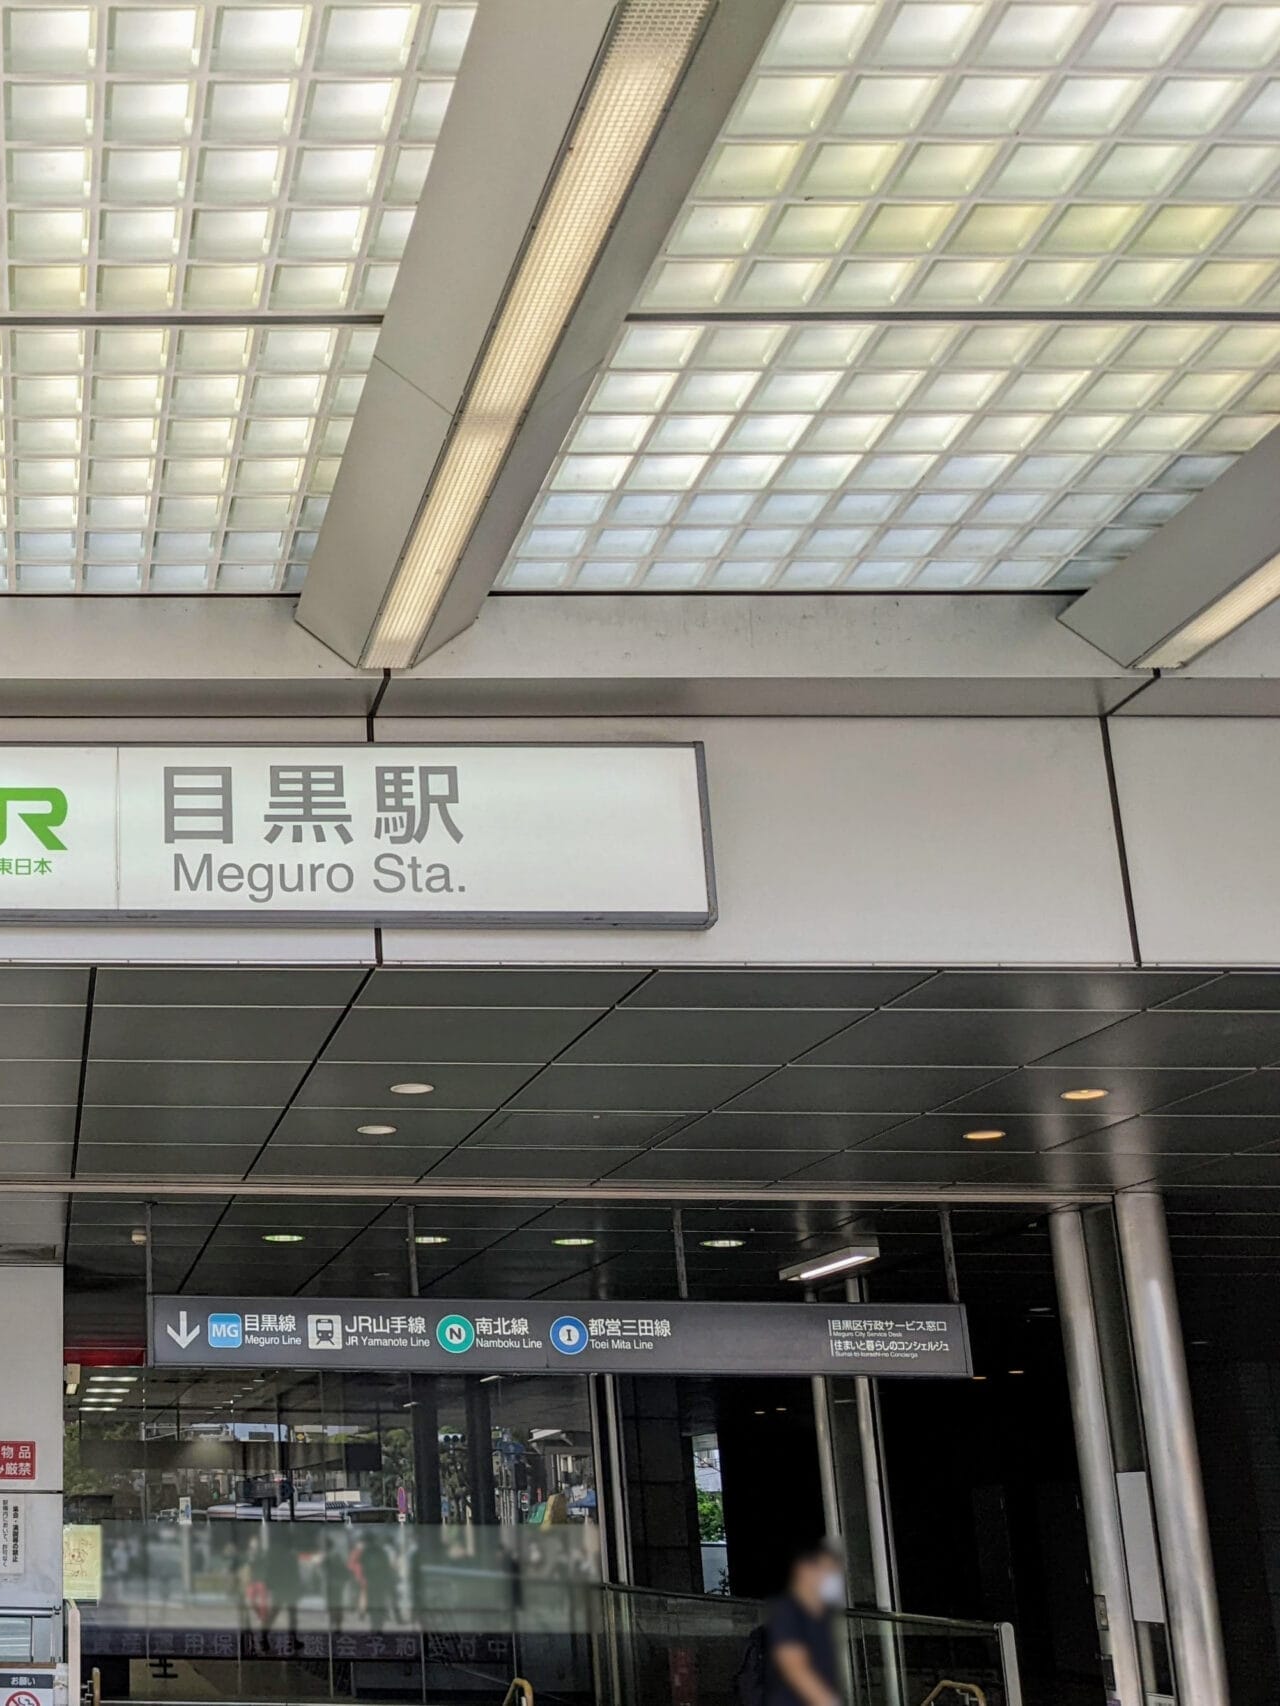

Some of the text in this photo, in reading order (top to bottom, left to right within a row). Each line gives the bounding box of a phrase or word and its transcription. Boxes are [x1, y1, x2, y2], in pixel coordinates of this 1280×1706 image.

[162, 765, 465, 846] 目黒駅
[173, 854, 467, 903] Meguro Sta.
[244, 1314, 297, 1332] 目黒線
[345, 1316, 426, 1334] JR山手線
[475, 1317, 529, 1335] 南北線
[589, 1319, 672, 1337] 都営三田線
[832, 1320, 947, 1331] 目黒区行政サービス窓口
[212, 1324, 239, 1338] MG
[450, 1328, 462, 1341] N
[244, 1334, 301, 1347] Meguro Line
[345, 1336, 430, 1347] JR Yamanote Line
[475, 1337, 542, 1348] Namboku Line
[589, 1340, 654, 1350] Toei Mita Line
[834, 1340, 950, 1351] 住まいと暮らしのコンシェルジュ
